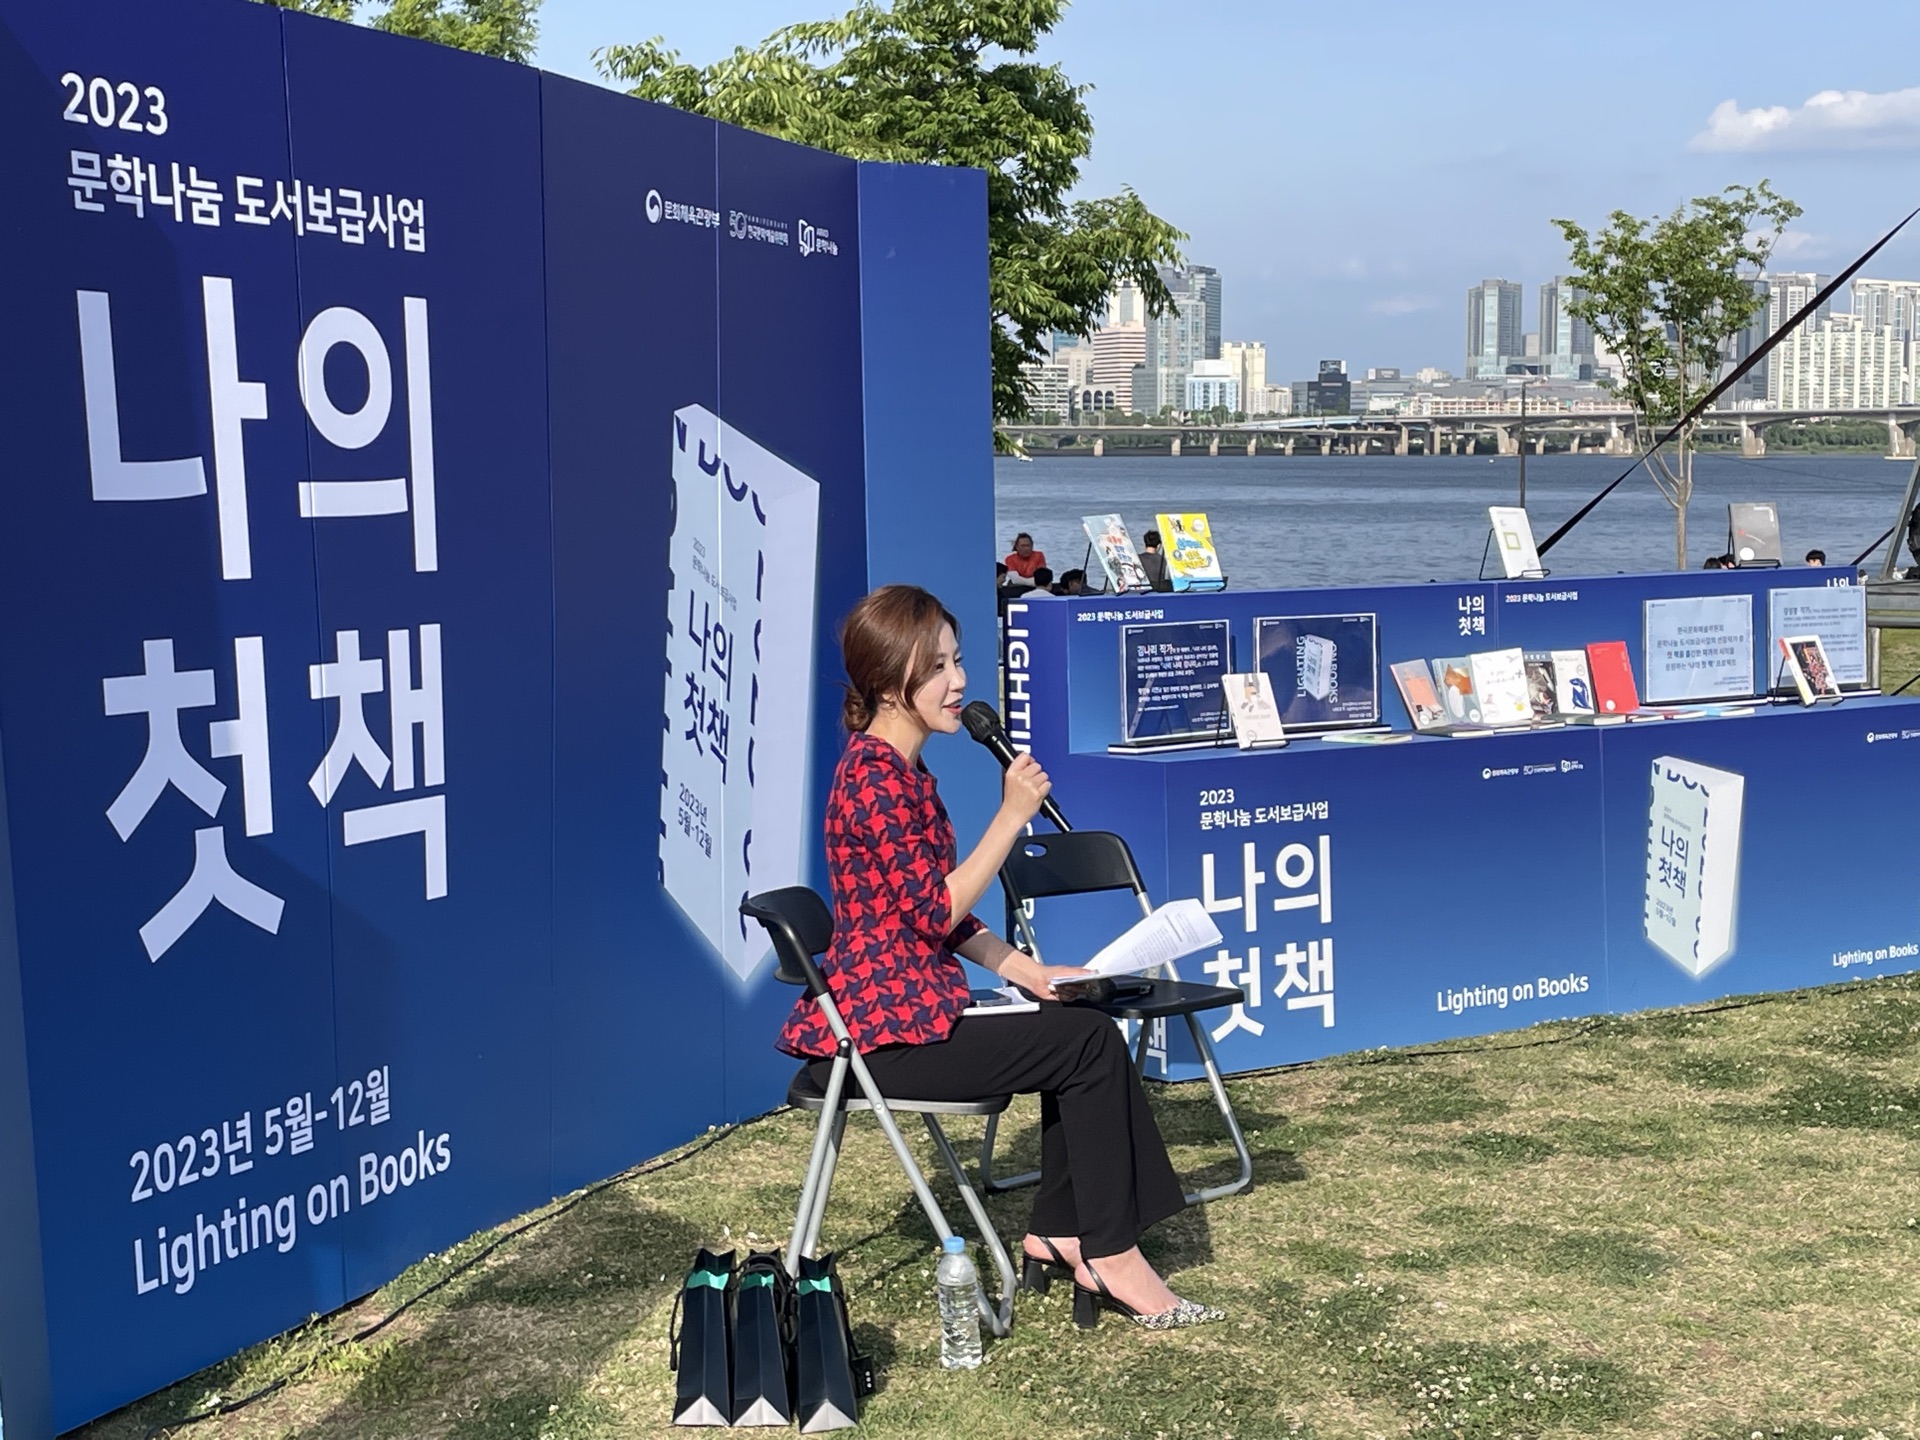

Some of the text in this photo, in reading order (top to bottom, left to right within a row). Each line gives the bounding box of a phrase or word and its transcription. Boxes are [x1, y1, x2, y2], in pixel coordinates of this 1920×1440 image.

[60, 72, 168, 136] 2023
[67, 150, 426, 253] 문학나눔 도서보급사업
[664, 200, 720, 228] 문화체육관광부
[76, 275, 438, 581] 나의
[1077, 609, 1164, 622] 2023 문학나눔 도서보급사업
[1458, 595, 1485, 615] 나의
[1458, 615, 1486, 636] 첫책
[688, 589, 733, 702] 나의
[684, 671, 730, 785] 첫책
[102, 623, 448, 963] 첫책
[678, 782, 708, 829] 2023년
[1199, 788, 1235, 806] 2023
[1199, 800, 1329, 831] 문학나눔 도서보급사업
[677, 806, 713, 860] 5월-12월
[1661, 825, 1689, 868] 나의
[1202, 834, 1333, 933] 나의
[1658, 857, 1687, 899] 첫책
[1833, 942, 1919, 968] Lighting on Books
[1203, 937, 1335, 1043] 첫책
[1437, 972, 1589, 1016] Lighting on Books
[129, 1066, 391, 1203] 2023년 5월-12월
[133, 1129, 452, 1296] Lighting on Books
